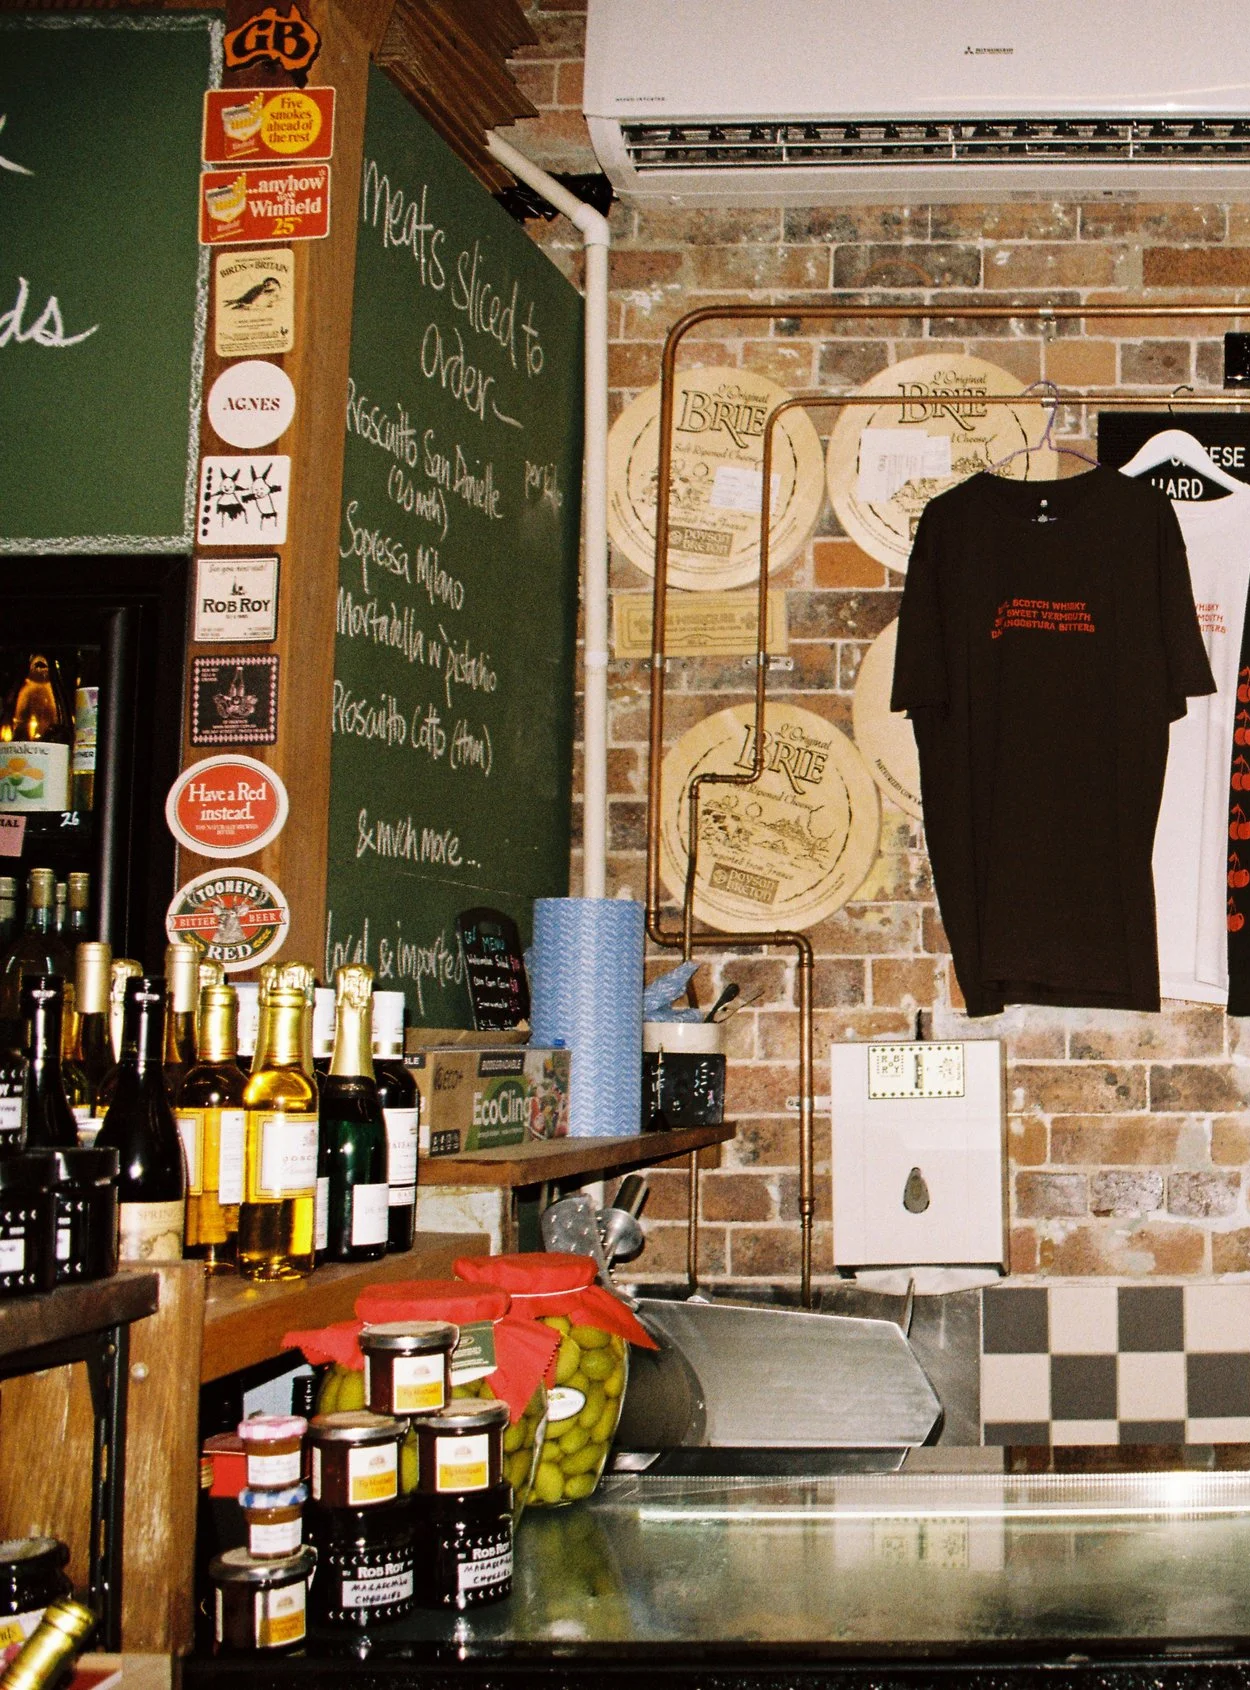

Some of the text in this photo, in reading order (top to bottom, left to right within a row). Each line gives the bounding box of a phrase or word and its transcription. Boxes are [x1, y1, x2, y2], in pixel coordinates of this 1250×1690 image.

[232, 19, 310, 60] GB
[280, 97, 303, 109] Five
[270, 110, 312, 121] smokes
[267, 119, 313, 132] ahead of
[269, 132, 310, 143] the rest
[248, 197, 322, 218] Winfield
[363, 157, 446, 291] Meats
[219, 260, 290, 279] BIRDS BRITAIN
[451, 240, 545, 378] Sliced to
[222, 397, 281, 411] AGNES
[897, 381, 988, 432] BRIE
[676, 389, 769, 449] BRIE
[202, 597, 271, 613] ROB ROY
[1012, 598, 1087, 611] SCOTCH WHISKY
[1006, 608, 1092, 622] SWEET VERMOUTH
[1058, 622, 1096, 633] BITTERS
[734, 724, 829, 795] BRIE
[188, 781, 268, 803] Have a Red
[59, 811, 81, 828] 26
[200, 801, 256, 822] instead.
[356, 807, 376, 858] &
[179, 912, 277, 927] BITTER BEER
[206, 944, 254, 961] RED
[379, 937, 394, 979] &
[472, 1090, 534, 1126] EcoCling
[472, 1546, 495, 1561] ROB
[357, 1561, 406, 1579] ROB ROY
